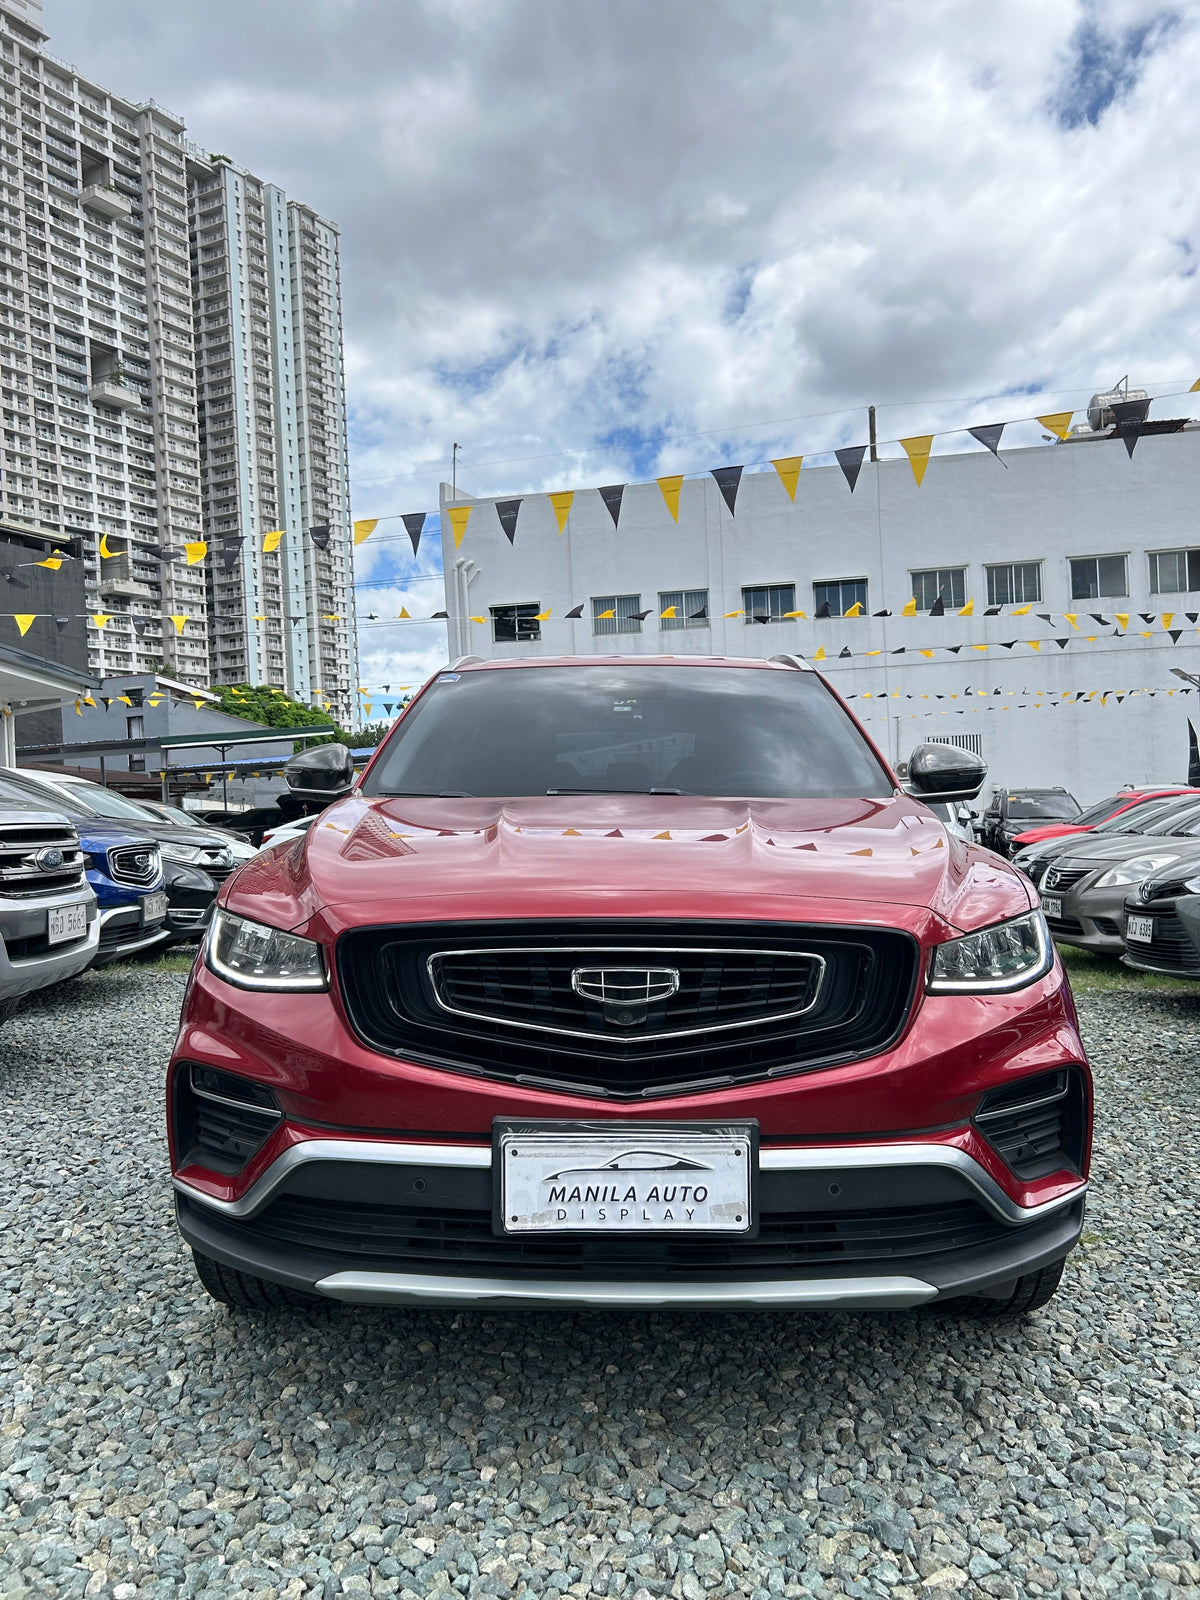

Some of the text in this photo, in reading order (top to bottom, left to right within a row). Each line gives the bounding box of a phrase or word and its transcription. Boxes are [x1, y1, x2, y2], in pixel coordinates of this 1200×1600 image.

[549, 1185, 708, 1203] MANILA AUTO
[557, 1208, 696, 1221] DISPLAY
